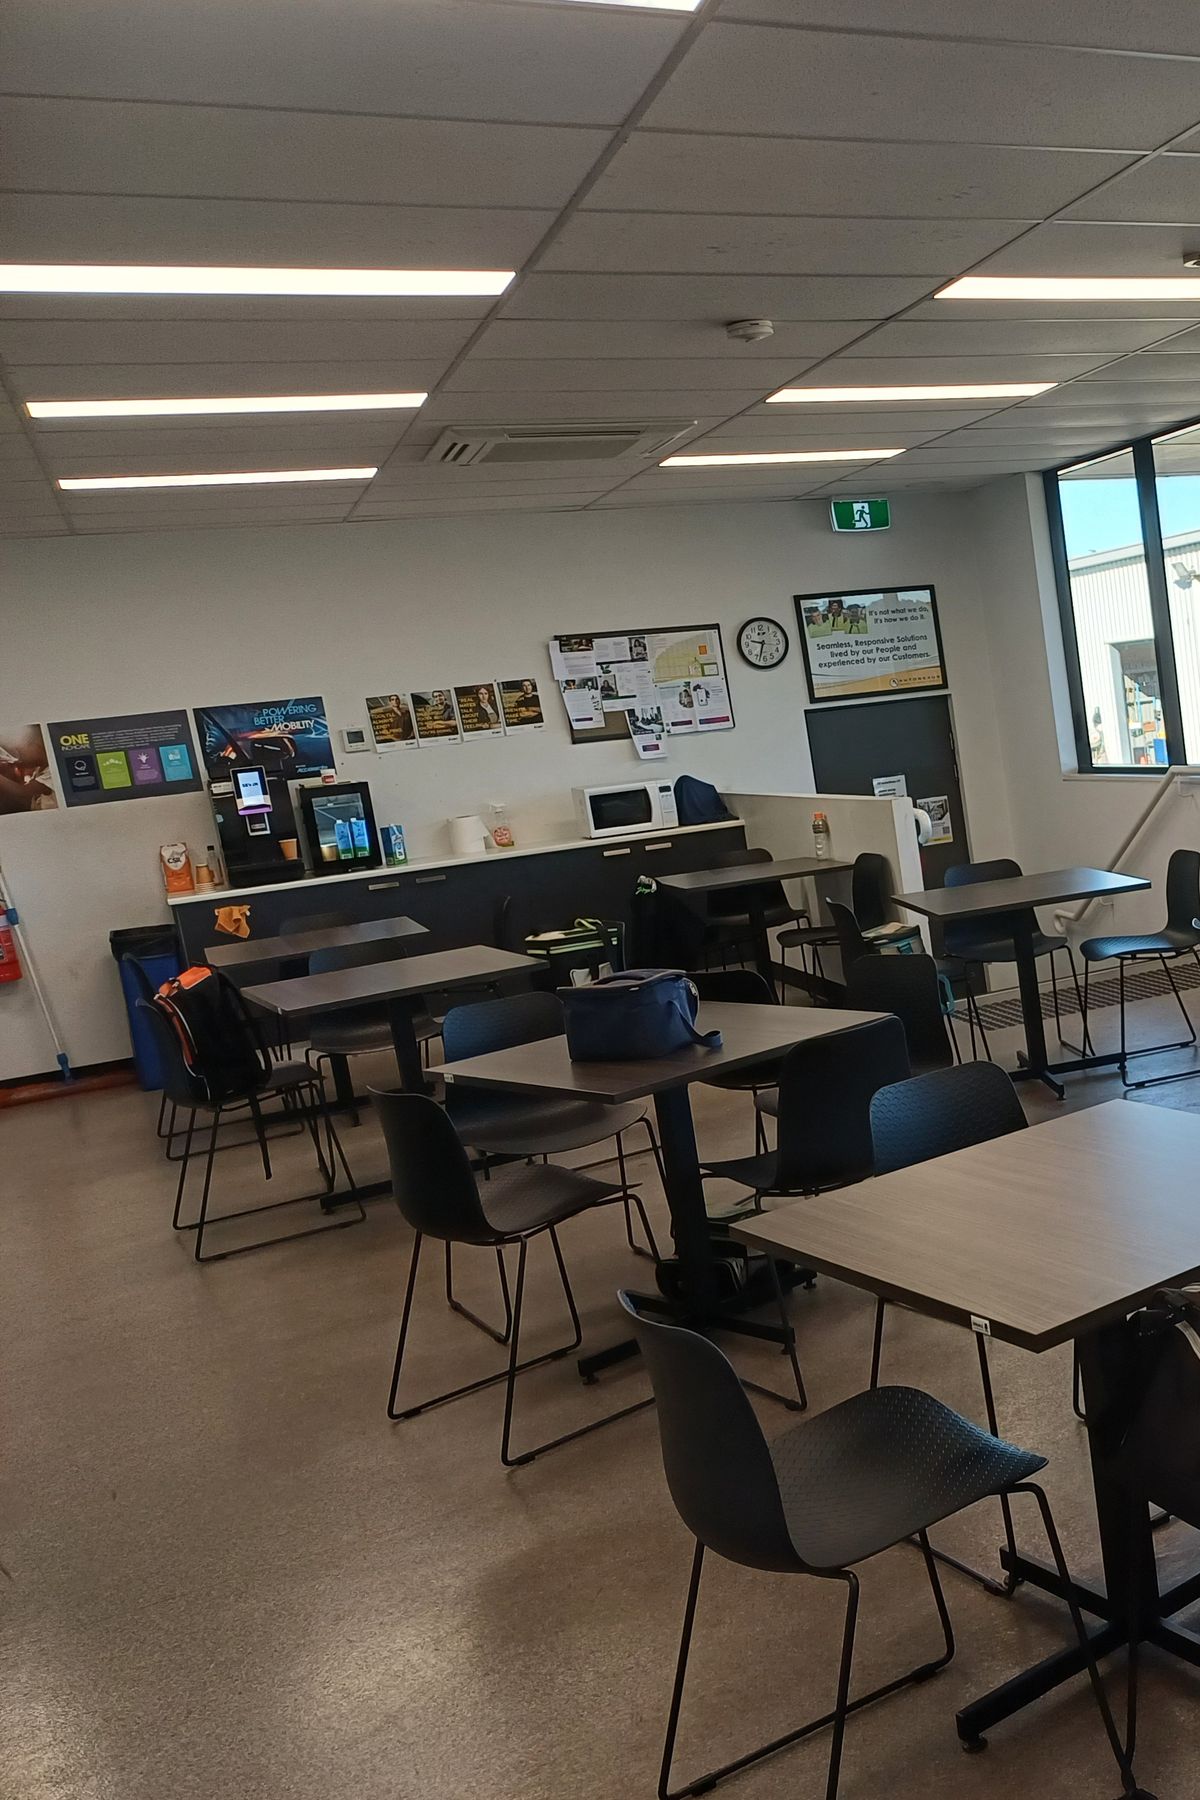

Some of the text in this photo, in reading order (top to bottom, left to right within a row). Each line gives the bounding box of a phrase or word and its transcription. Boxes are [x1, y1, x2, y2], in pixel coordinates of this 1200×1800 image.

[816, 634, 928, 651] Seamless, Responsive Solutions
[830, 643, 917, 658] lived by our People and
[818, 658, 865, 669] experienced
[867, 656, 876, 664] by
[892, 651, 931, 661] Customers.
[262, 700, 317, 717] POWERING
[254, 715, 285, 725] BETTER
[271, 720, 314, 731] MOBILITY
[60, 733, 90, 746] ONE
